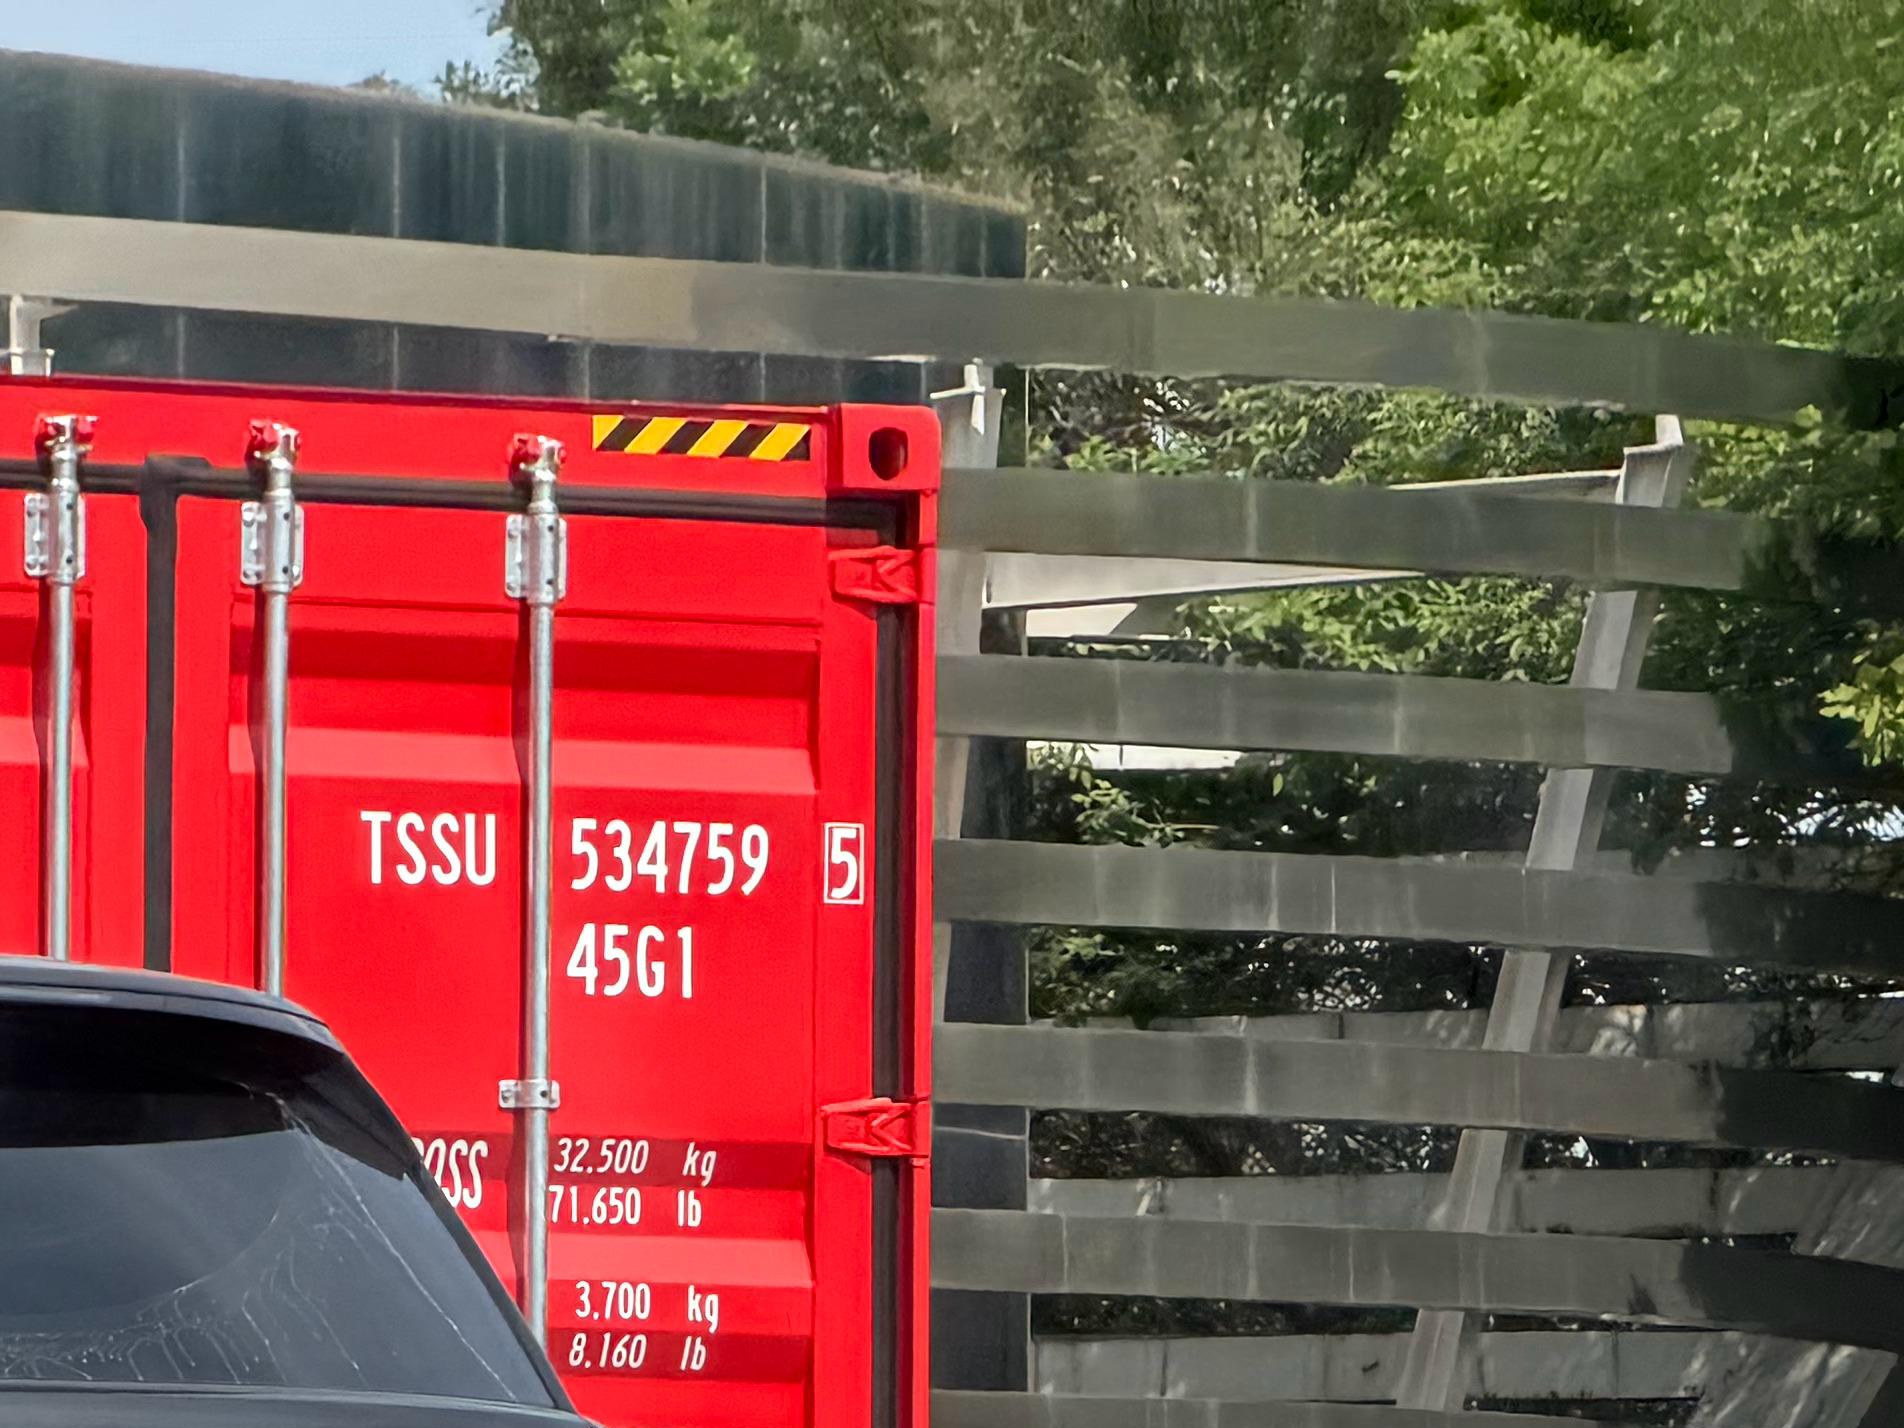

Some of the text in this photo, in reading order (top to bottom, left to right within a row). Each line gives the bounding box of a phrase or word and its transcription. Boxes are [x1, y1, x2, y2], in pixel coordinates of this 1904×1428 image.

[360, 810, 862, 902] TSSU 534759 5
[566, 922, 694, 999] 45G1
[553, 1137, 649, 1174] 32.500
[682, 1142, 717, 1187] kg
[547, 1184, 703, 1227] 71.650 lb
[575, 1280, 719, 1331] 3.700 kg
[568, 1332, 706, 1371] 8.160 lb
